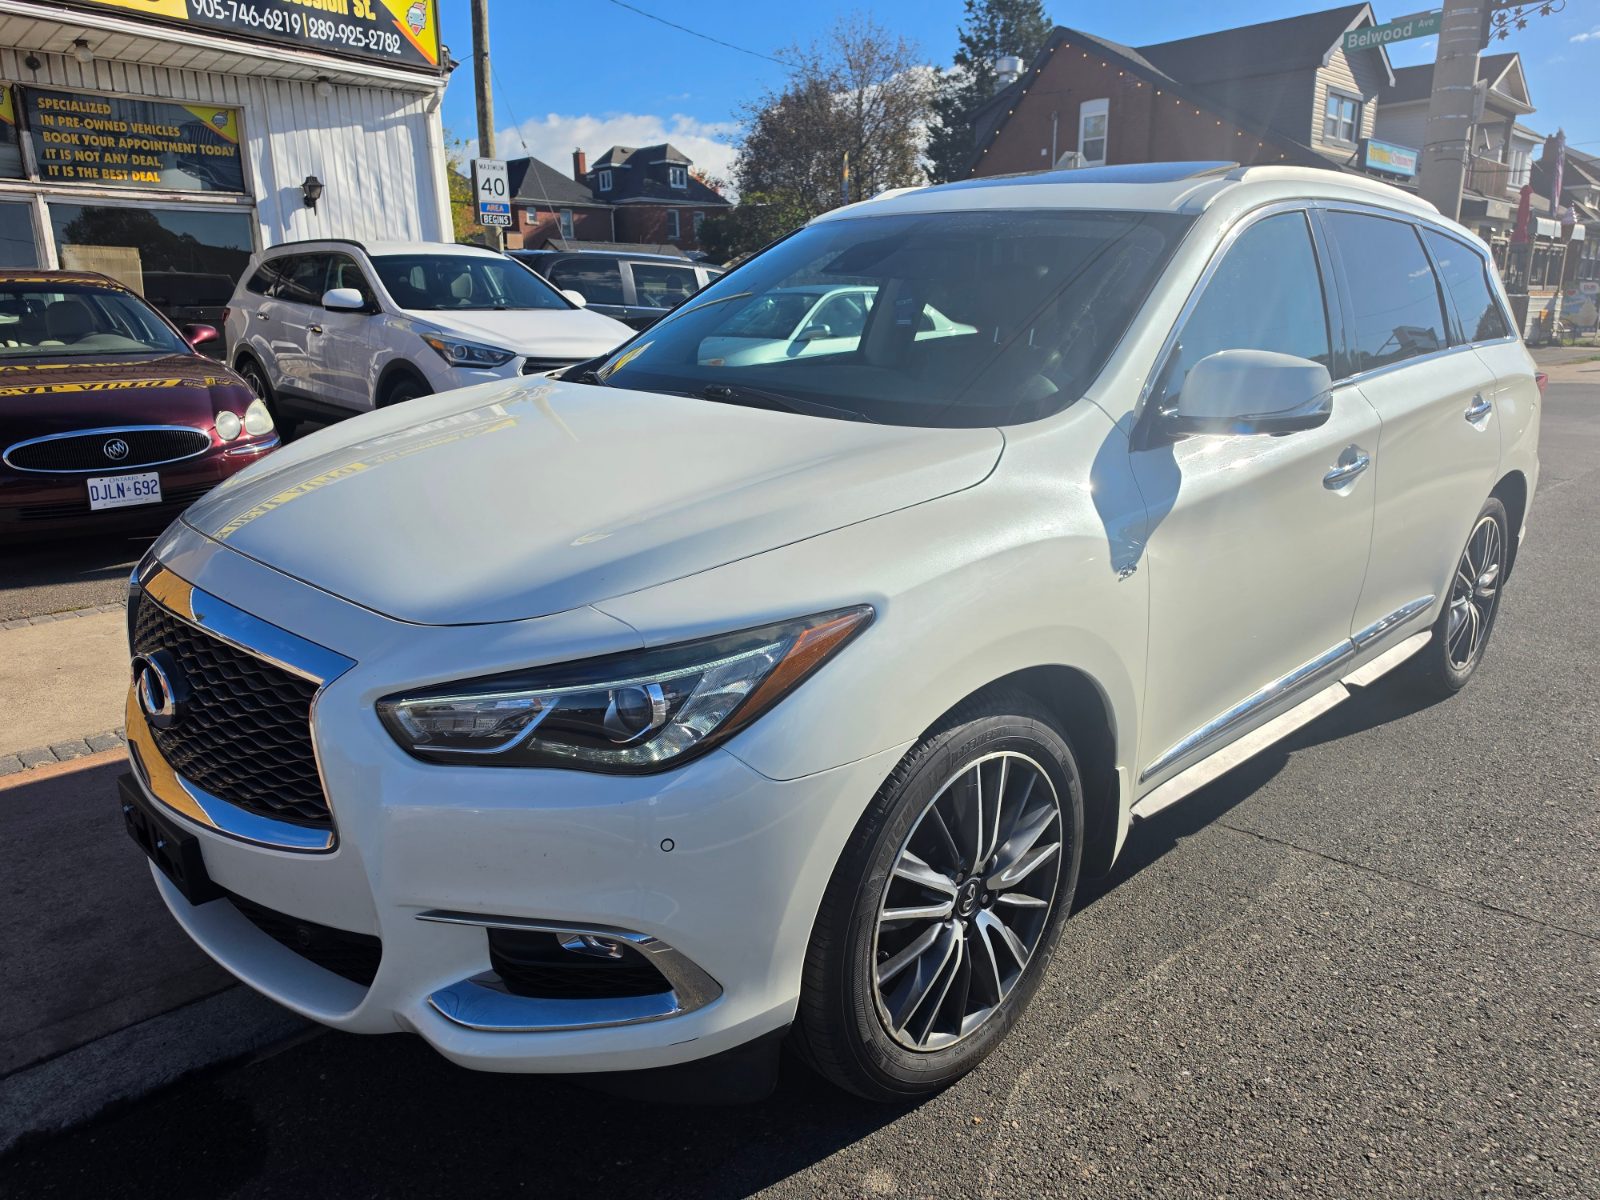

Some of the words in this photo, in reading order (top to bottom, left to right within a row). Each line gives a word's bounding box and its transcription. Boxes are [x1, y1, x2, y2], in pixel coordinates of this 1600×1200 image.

[1347, 22, 1413, 48] Belwood
[1418, 18, 1434, 28] Ave
[37, 97, 111, 114] SPECIALIZED
[41, 114, 54, 126] IN
[57, 116, 128, 132] PRE-OWNED
[130, 122, 181, 137] VEHICLES
[43, 131, 80, 145] BOOK
[82, 134, 115, 148] YOUR
[118, 137, 198, 154] APPOINTMENT
[199, 144, 235, 157] TODAY
[46, 148, 57, 160] IT
[61, 149, 71, 161] IS
[75, 150, 100, 162] NOT
[104, 152, 128, 164] ANY
[131, 154, 164, 169] DEAL,
[48, 165, 59, 176] IT
[63, 165, 74, 177] IS
[77, 166, 99, 178] THE
[102, 168, 128, 181] BEST
[131, 171, 161, 183] DEAL
[481, 177, 505, 196] 40
[483, 214, 509, 225] BEGINS
[90, 482, 126, 501] DJLN
[133, 479, 159, 496] 692
